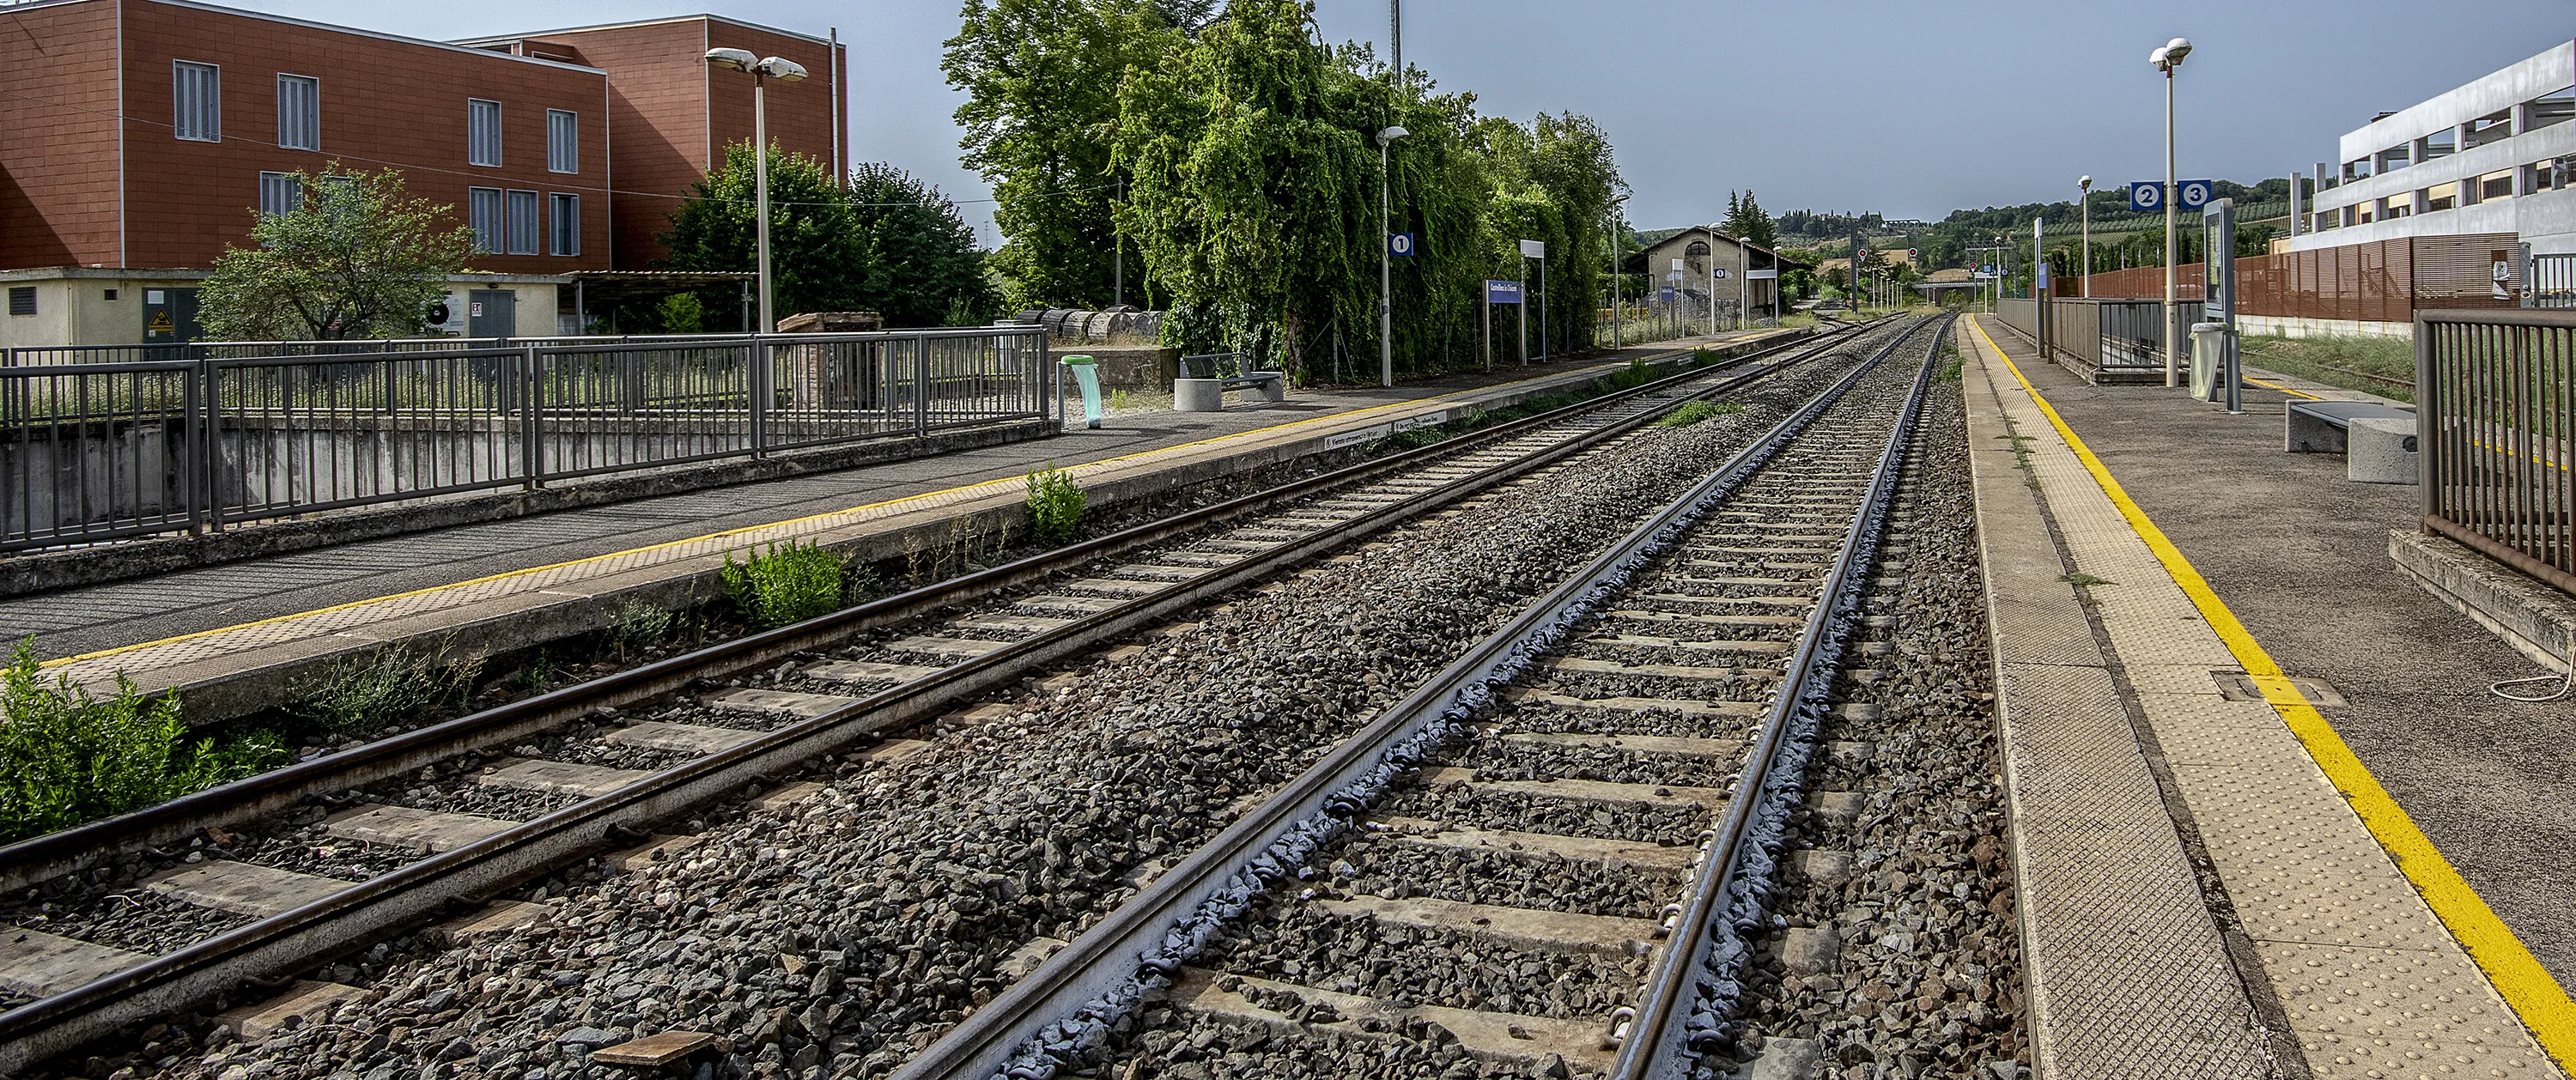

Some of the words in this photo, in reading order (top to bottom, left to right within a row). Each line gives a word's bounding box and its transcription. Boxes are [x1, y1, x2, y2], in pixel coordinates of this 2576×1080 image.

[2141, 188, 2154, 203] 2
[2189, 187, 2202, 202] 3
[1398, 238, 1404, 250] 1
